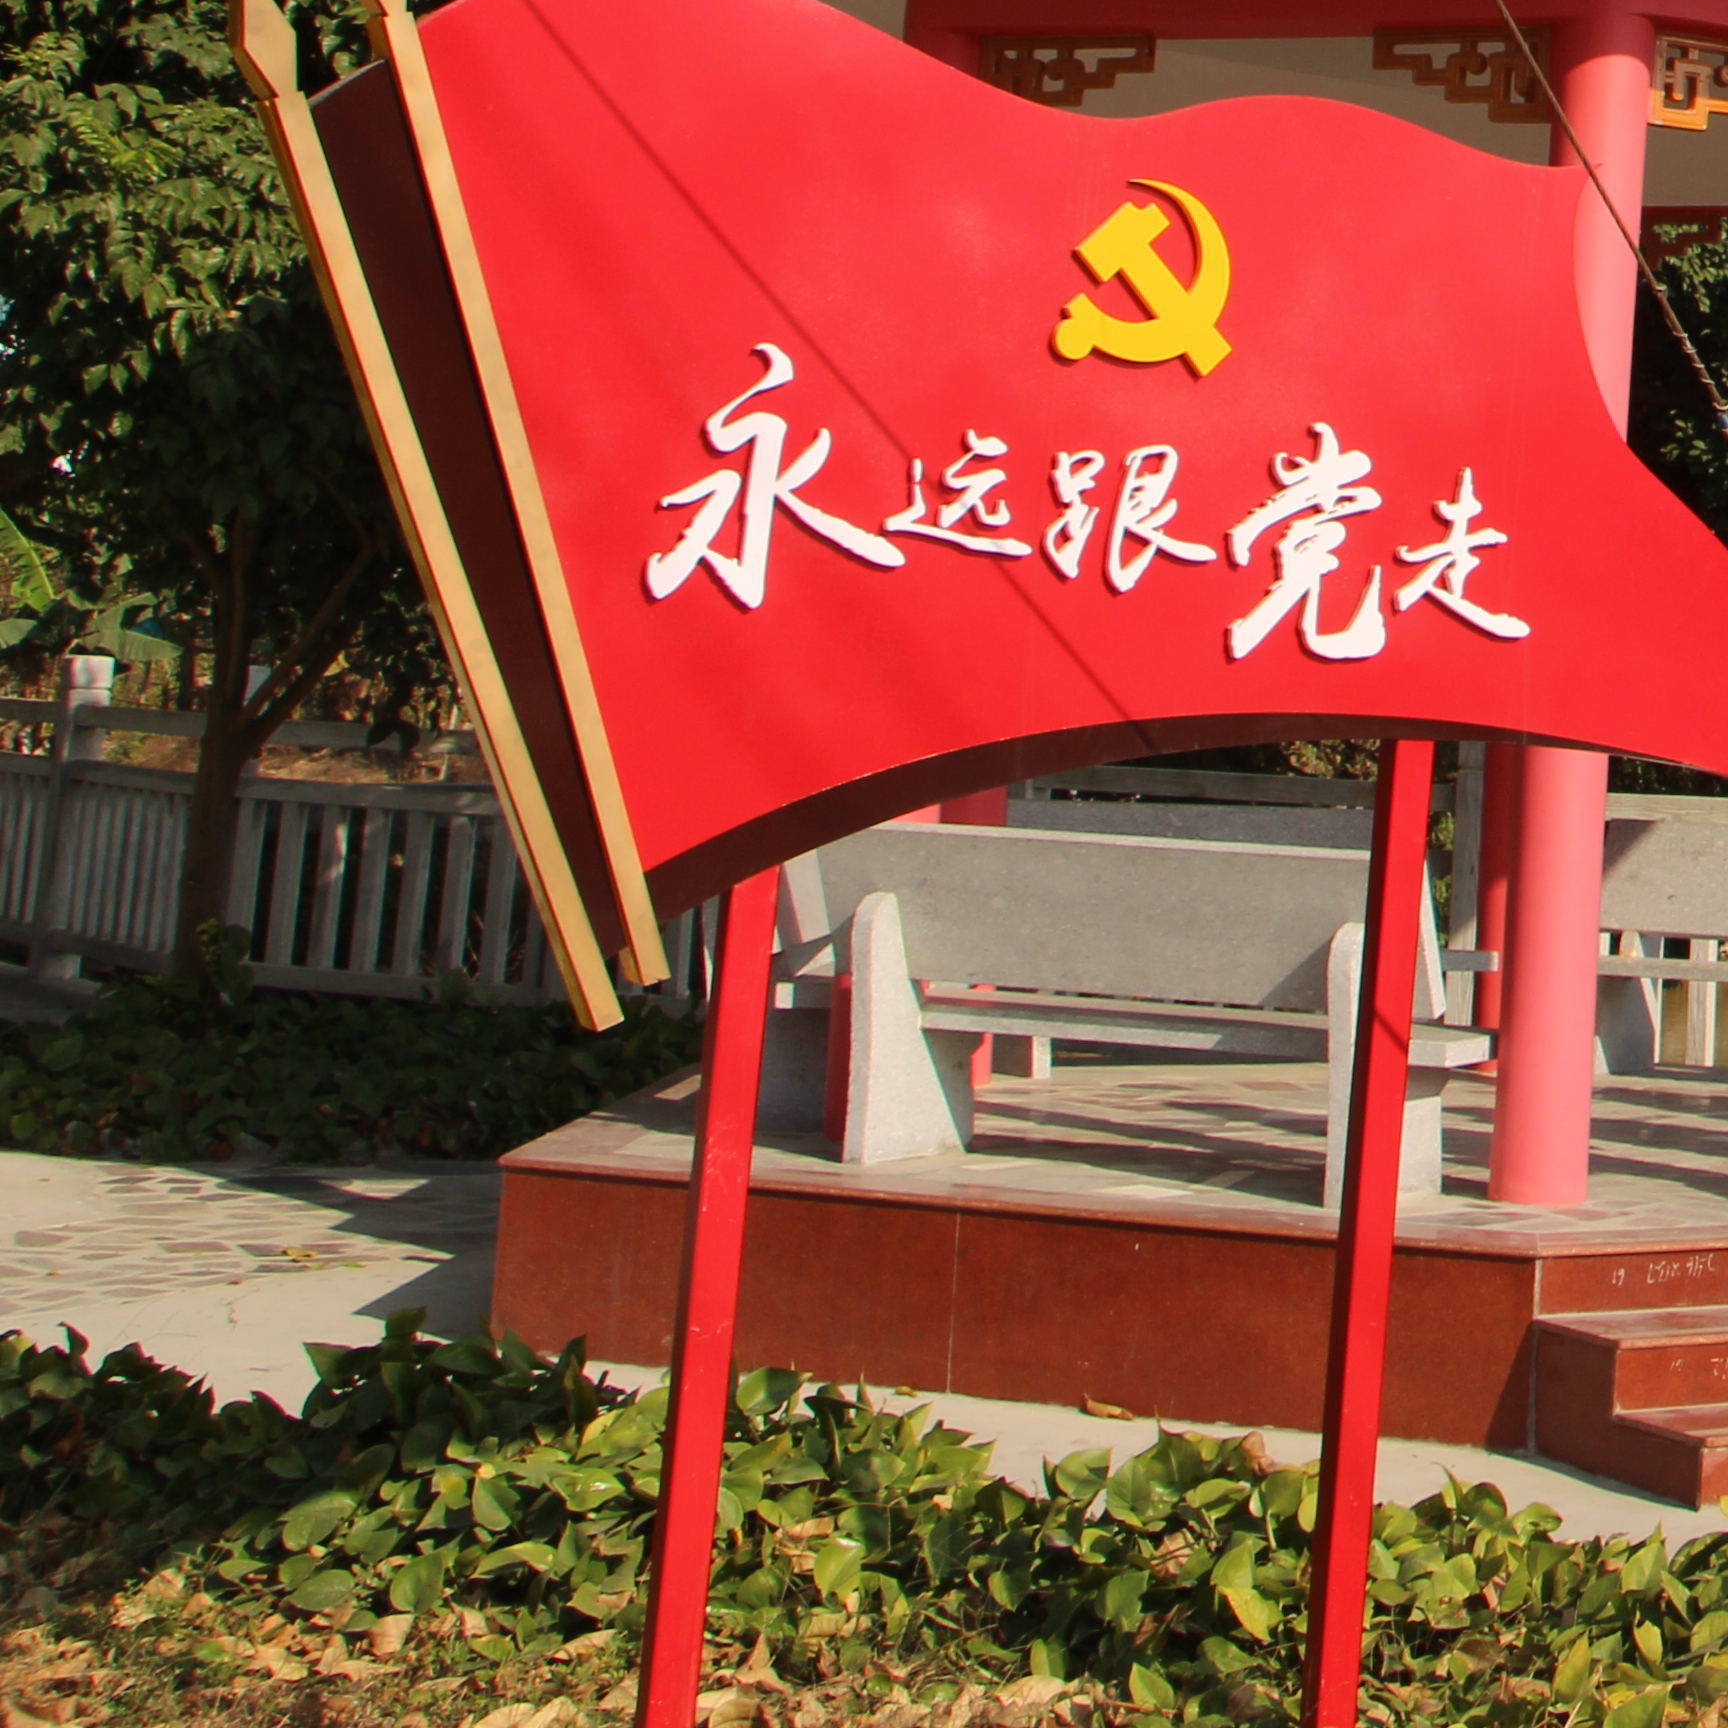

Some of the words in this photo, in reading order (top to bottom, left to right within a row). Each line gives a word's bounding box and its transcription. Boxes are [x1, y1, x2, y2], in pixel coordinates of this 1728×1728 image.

[643, 342, 1531, 660] 永远跟党走
